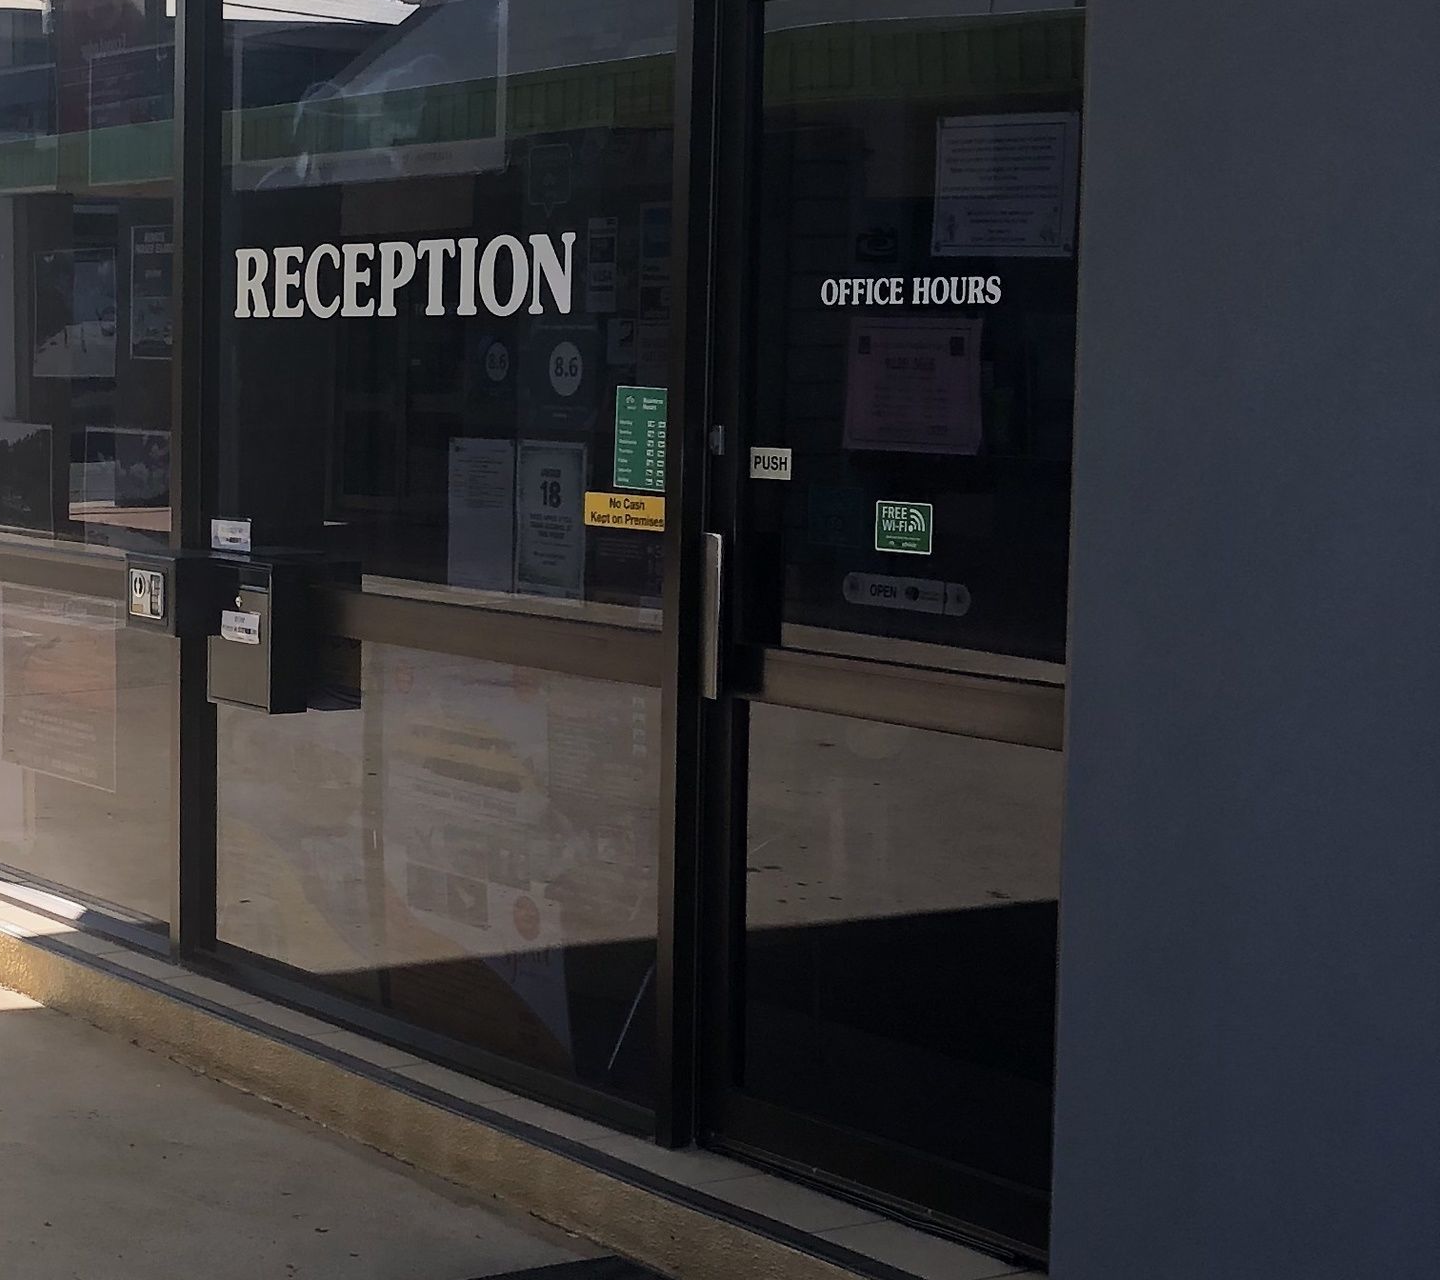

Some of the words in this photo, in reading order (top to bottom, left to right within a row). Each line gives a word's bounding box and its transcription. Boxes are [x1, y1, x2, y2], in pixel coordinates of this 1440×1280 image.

[234, 232, 576, 319] RECEPTION
[820, 277, 904, 306] OFFICE
[911, 275, 1002, 305] HOURS
[554, 356, 578, 377] 8.6
[754, 455, 788, 471] PUSH
[540, 480, 561, 508] 18
[609, 497, 622, 509] No
[623, 498, 645, 510] Cash
[590, 511, 610, 524] Kept
[612, 515, 623, 524] on
[625, 513, 664, 527] Premises
[882, 506, 908, 520] FREE
[882, 519, 908, 532] WI-FI
[870, 583, 897, 598] OPEN
